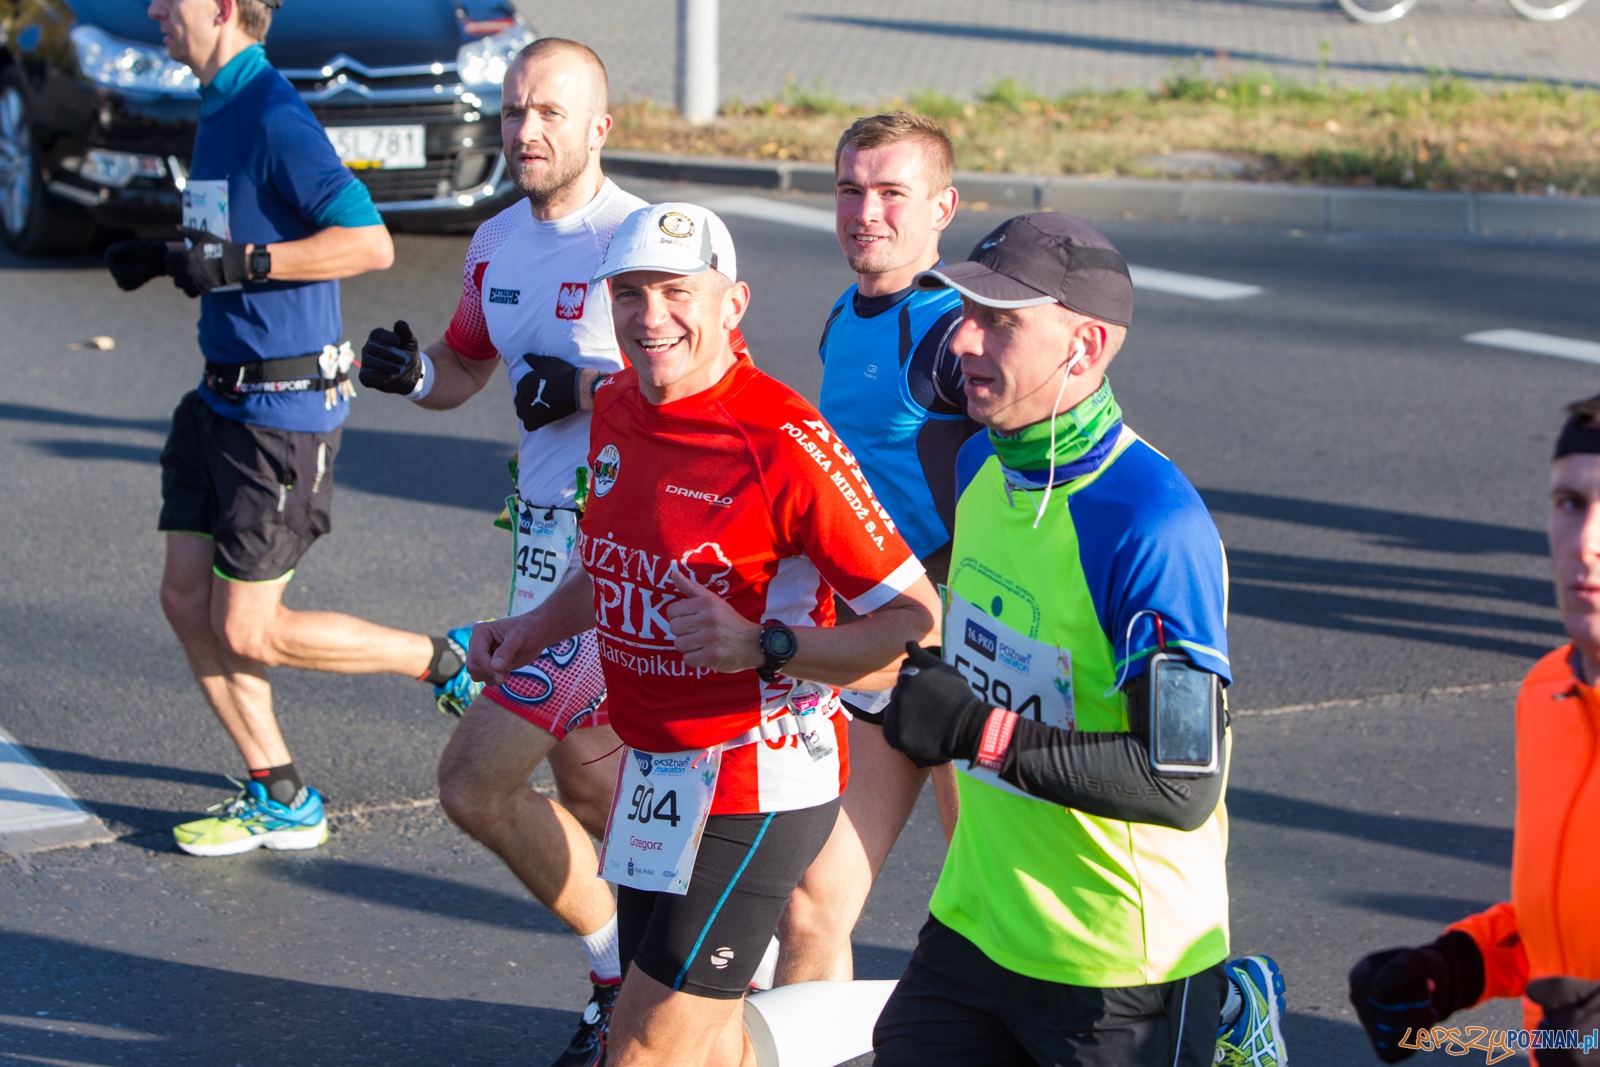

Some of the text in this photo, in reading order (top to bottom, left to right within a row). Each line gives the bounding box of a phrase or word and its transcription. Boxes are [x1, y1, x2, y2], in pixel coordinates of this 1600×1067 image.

[603, 446, 617, 461] MTS
[665, 484, 734, 505] DANIELO
[779, 422, 885, 552] POLSKA MIEDŹ S.A.
[517, 545, 557, 583] 455
[599, 637, 717, 680] darszpiku.p
[998, 652, 1031, 675] maraton
[654, 765, 687, 775] maraton
[627, 784, 681, 828] 904
[629, 835, 664, 852] Grzegorz
